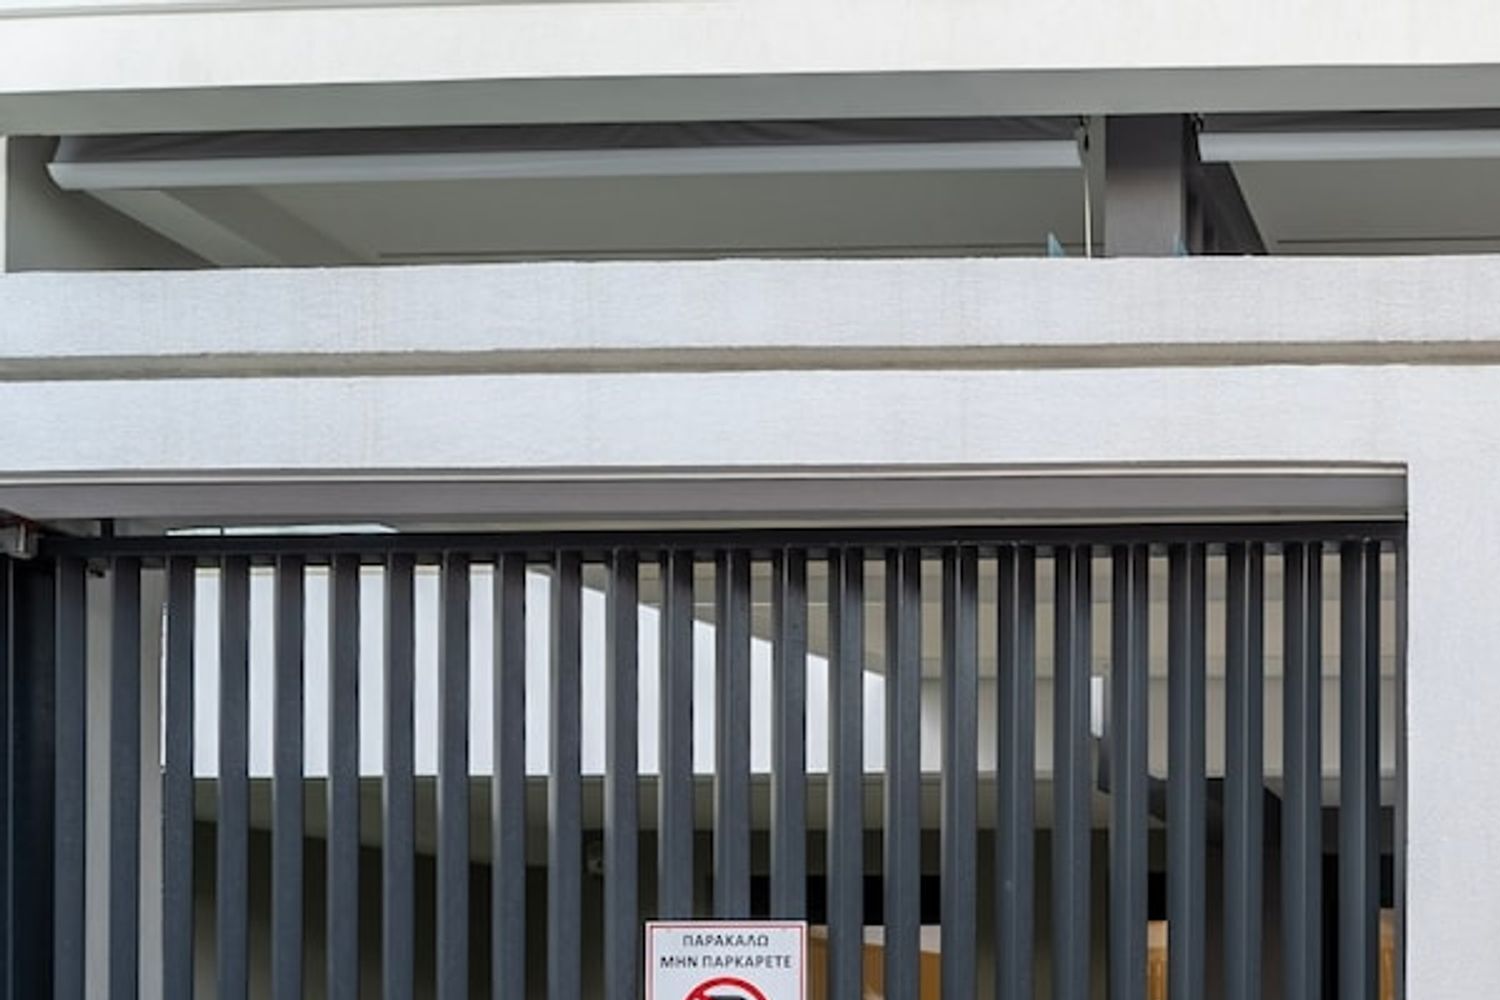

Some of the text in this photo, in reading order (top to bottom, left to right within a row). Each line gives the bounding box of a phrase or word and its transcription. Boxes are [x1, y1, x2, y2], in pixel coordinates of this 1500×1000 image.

[682, 934, 769, 947] ΠΑΡΑΚΑΛΩ
[660, 955, 792, 968] ΜΗΝ ΠΑΡΚΑΡΕΤΕ
